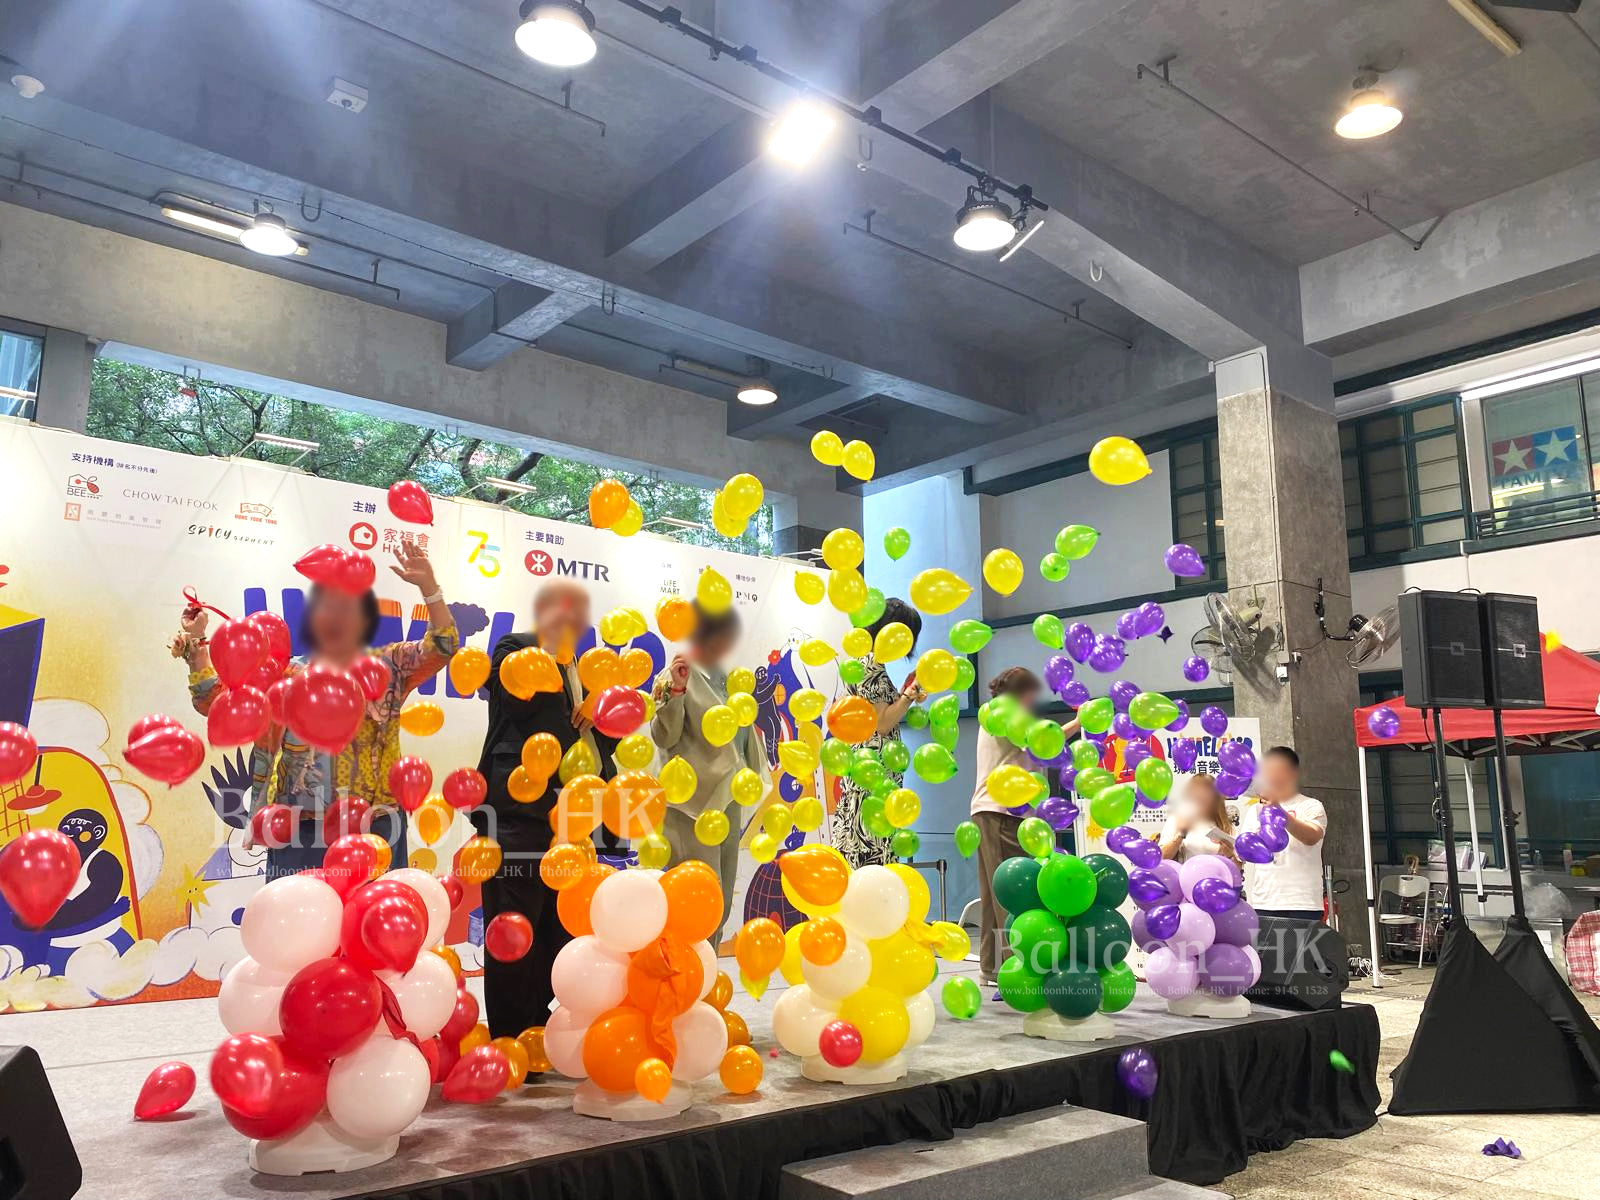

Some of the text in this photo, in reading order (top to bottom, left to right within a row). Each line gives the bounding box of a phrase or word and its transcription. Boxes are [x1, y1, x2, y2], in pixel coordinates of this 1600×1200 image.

[71, 452, 114, 468] 支持機構
[66, 487, 87, 498] BEE
[122, 488, 219, 512] CHOW TAI FOOK
[352, 501, 377, 515] 主辦
[383, 528, 431, 548] 家福會
[557, 557, 610, 582] MTR
